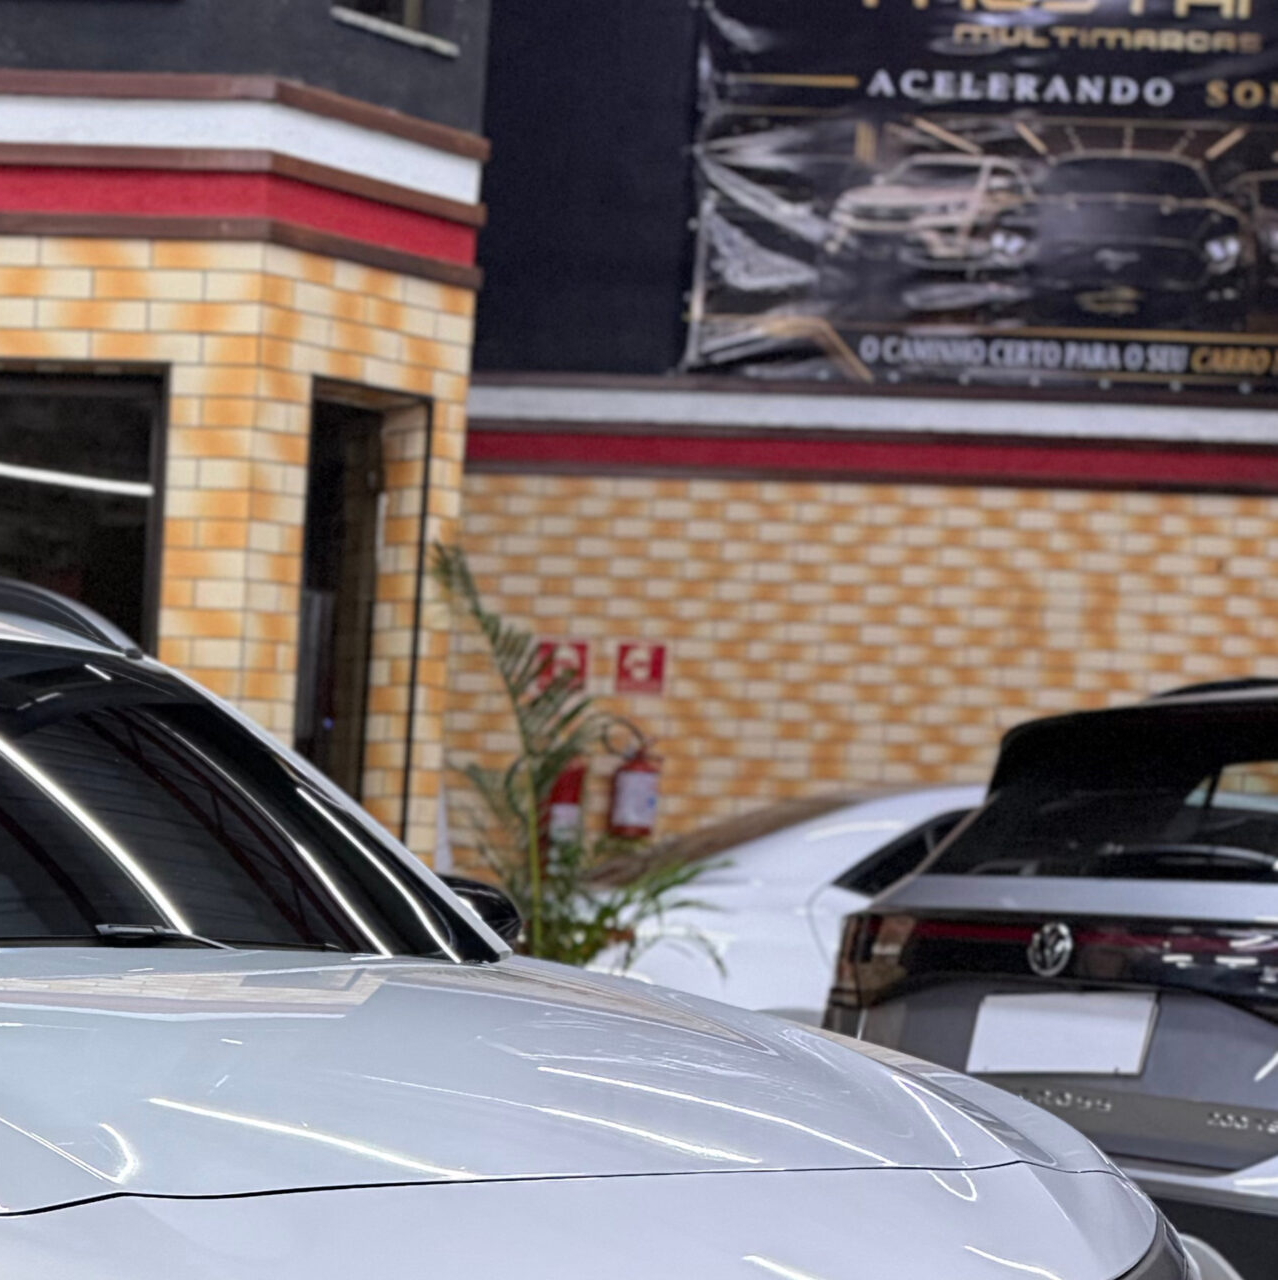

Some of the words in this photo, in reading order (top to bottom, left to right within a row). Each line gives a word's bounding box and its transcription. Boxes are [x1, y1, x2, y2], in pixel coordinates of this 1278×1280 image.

[866, 68, 1175, 106] ACELERANDO
[859, 334, 880, 364] O
[1123, 342, 1145, 372] O
